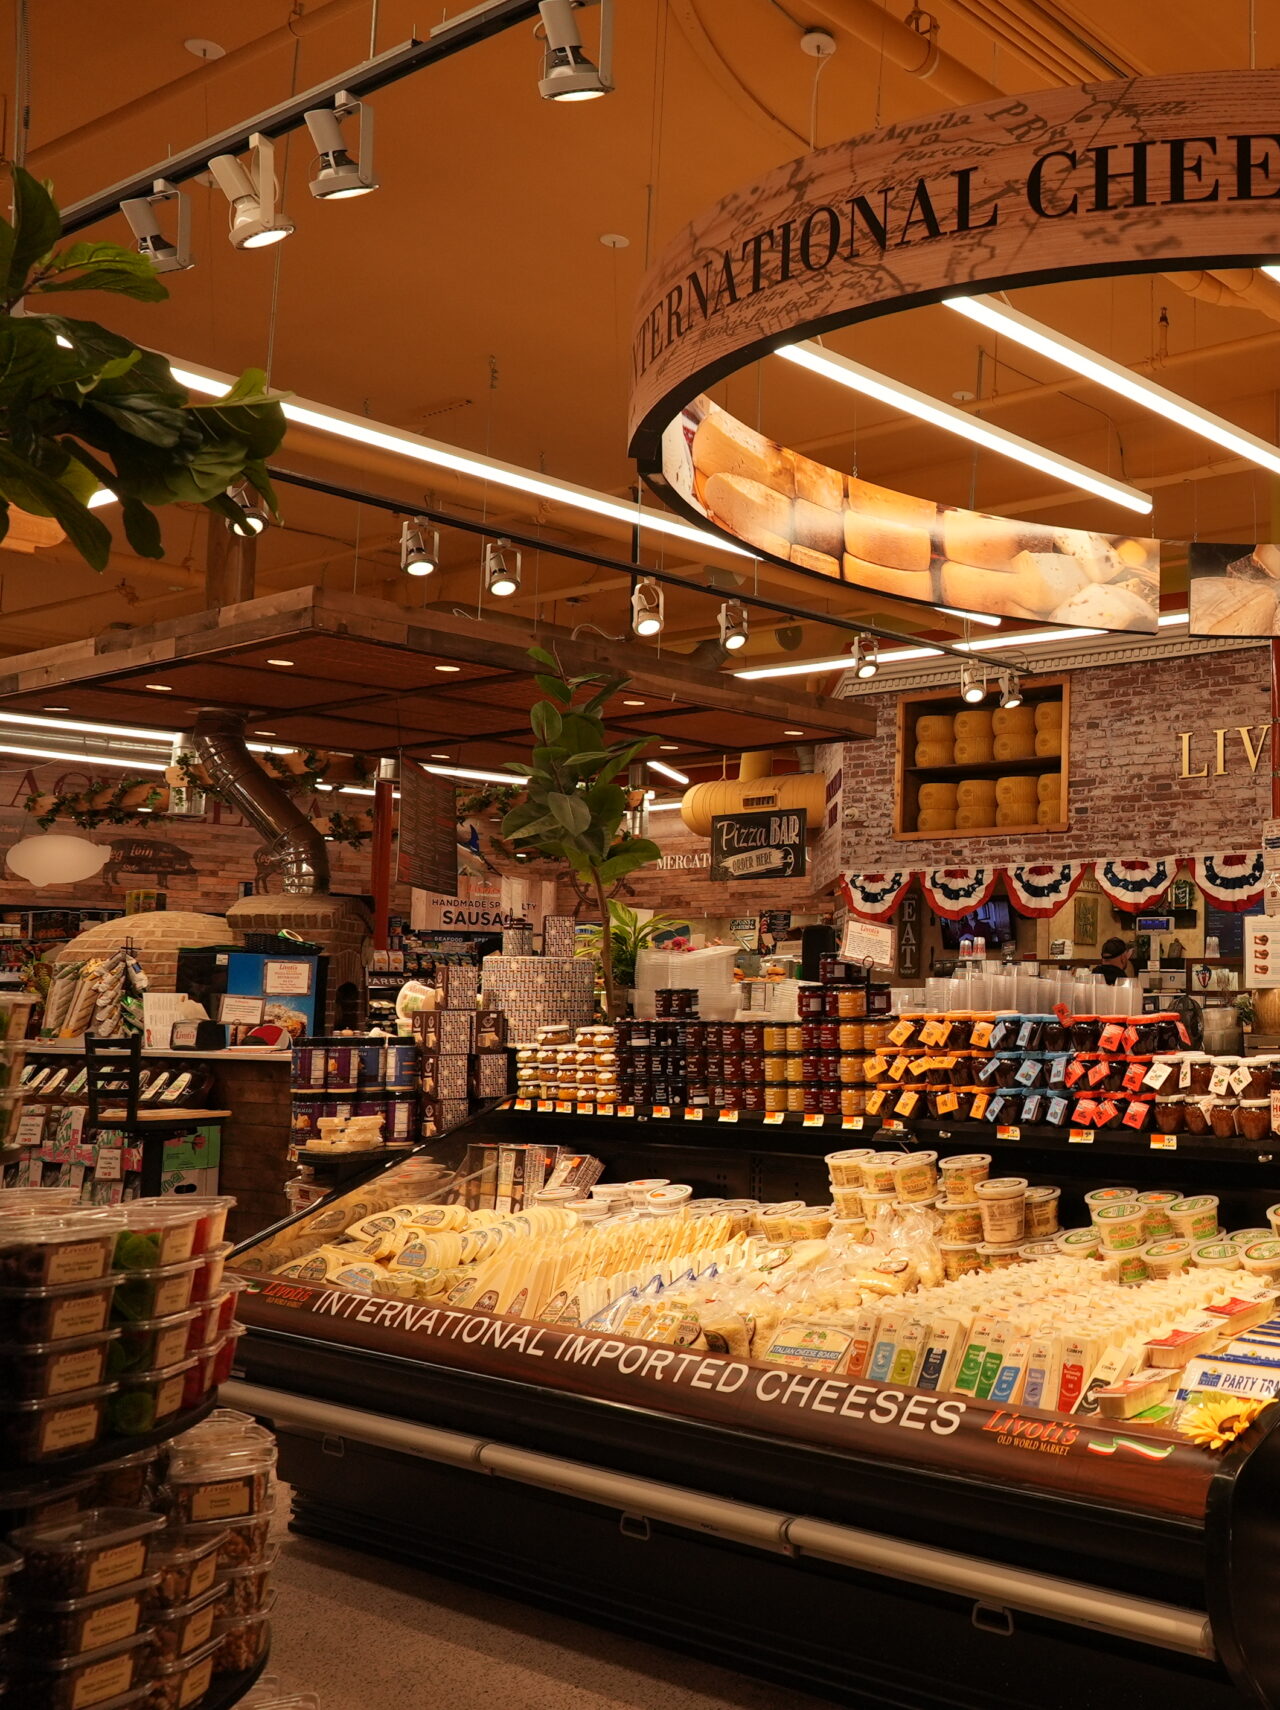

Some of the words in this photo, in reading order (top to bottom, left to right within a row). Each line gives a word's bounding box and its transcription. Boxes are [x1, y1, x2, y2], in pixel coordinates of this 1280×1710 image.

[717, 821, 767, 850] Pizza
[770, 815, 800, 845] BAR
[656, 853, 712, 870] MERCAT
[733, 855, 754, 872] ORDER
[756, 851, 773, 866] HERE
[432, 899, 486, 908] HANDMADE
[901, 901, 916, 968] EAT
[772, 1345, 793, 1354] ITALIAN
[795, 1348, 817, 1357] CHEESE
[818, 1351, 840, 1359] BOARD
[312, 1289, 545, 1357] INTERNATIONAL
[554, 1333, 750, 1393] IMPORTED
[756, 1370, 967, 1435] CHEESES
[982, 1409, 1080, 1445] Livoti's
[1222, 1374, 1258, 1391] PARTY
[997, 1436, 1012, 1445] OLD
[1013, 1437, 1038, 1451] WORLD
[1040, 1442, 1070, 1456] MARKET
